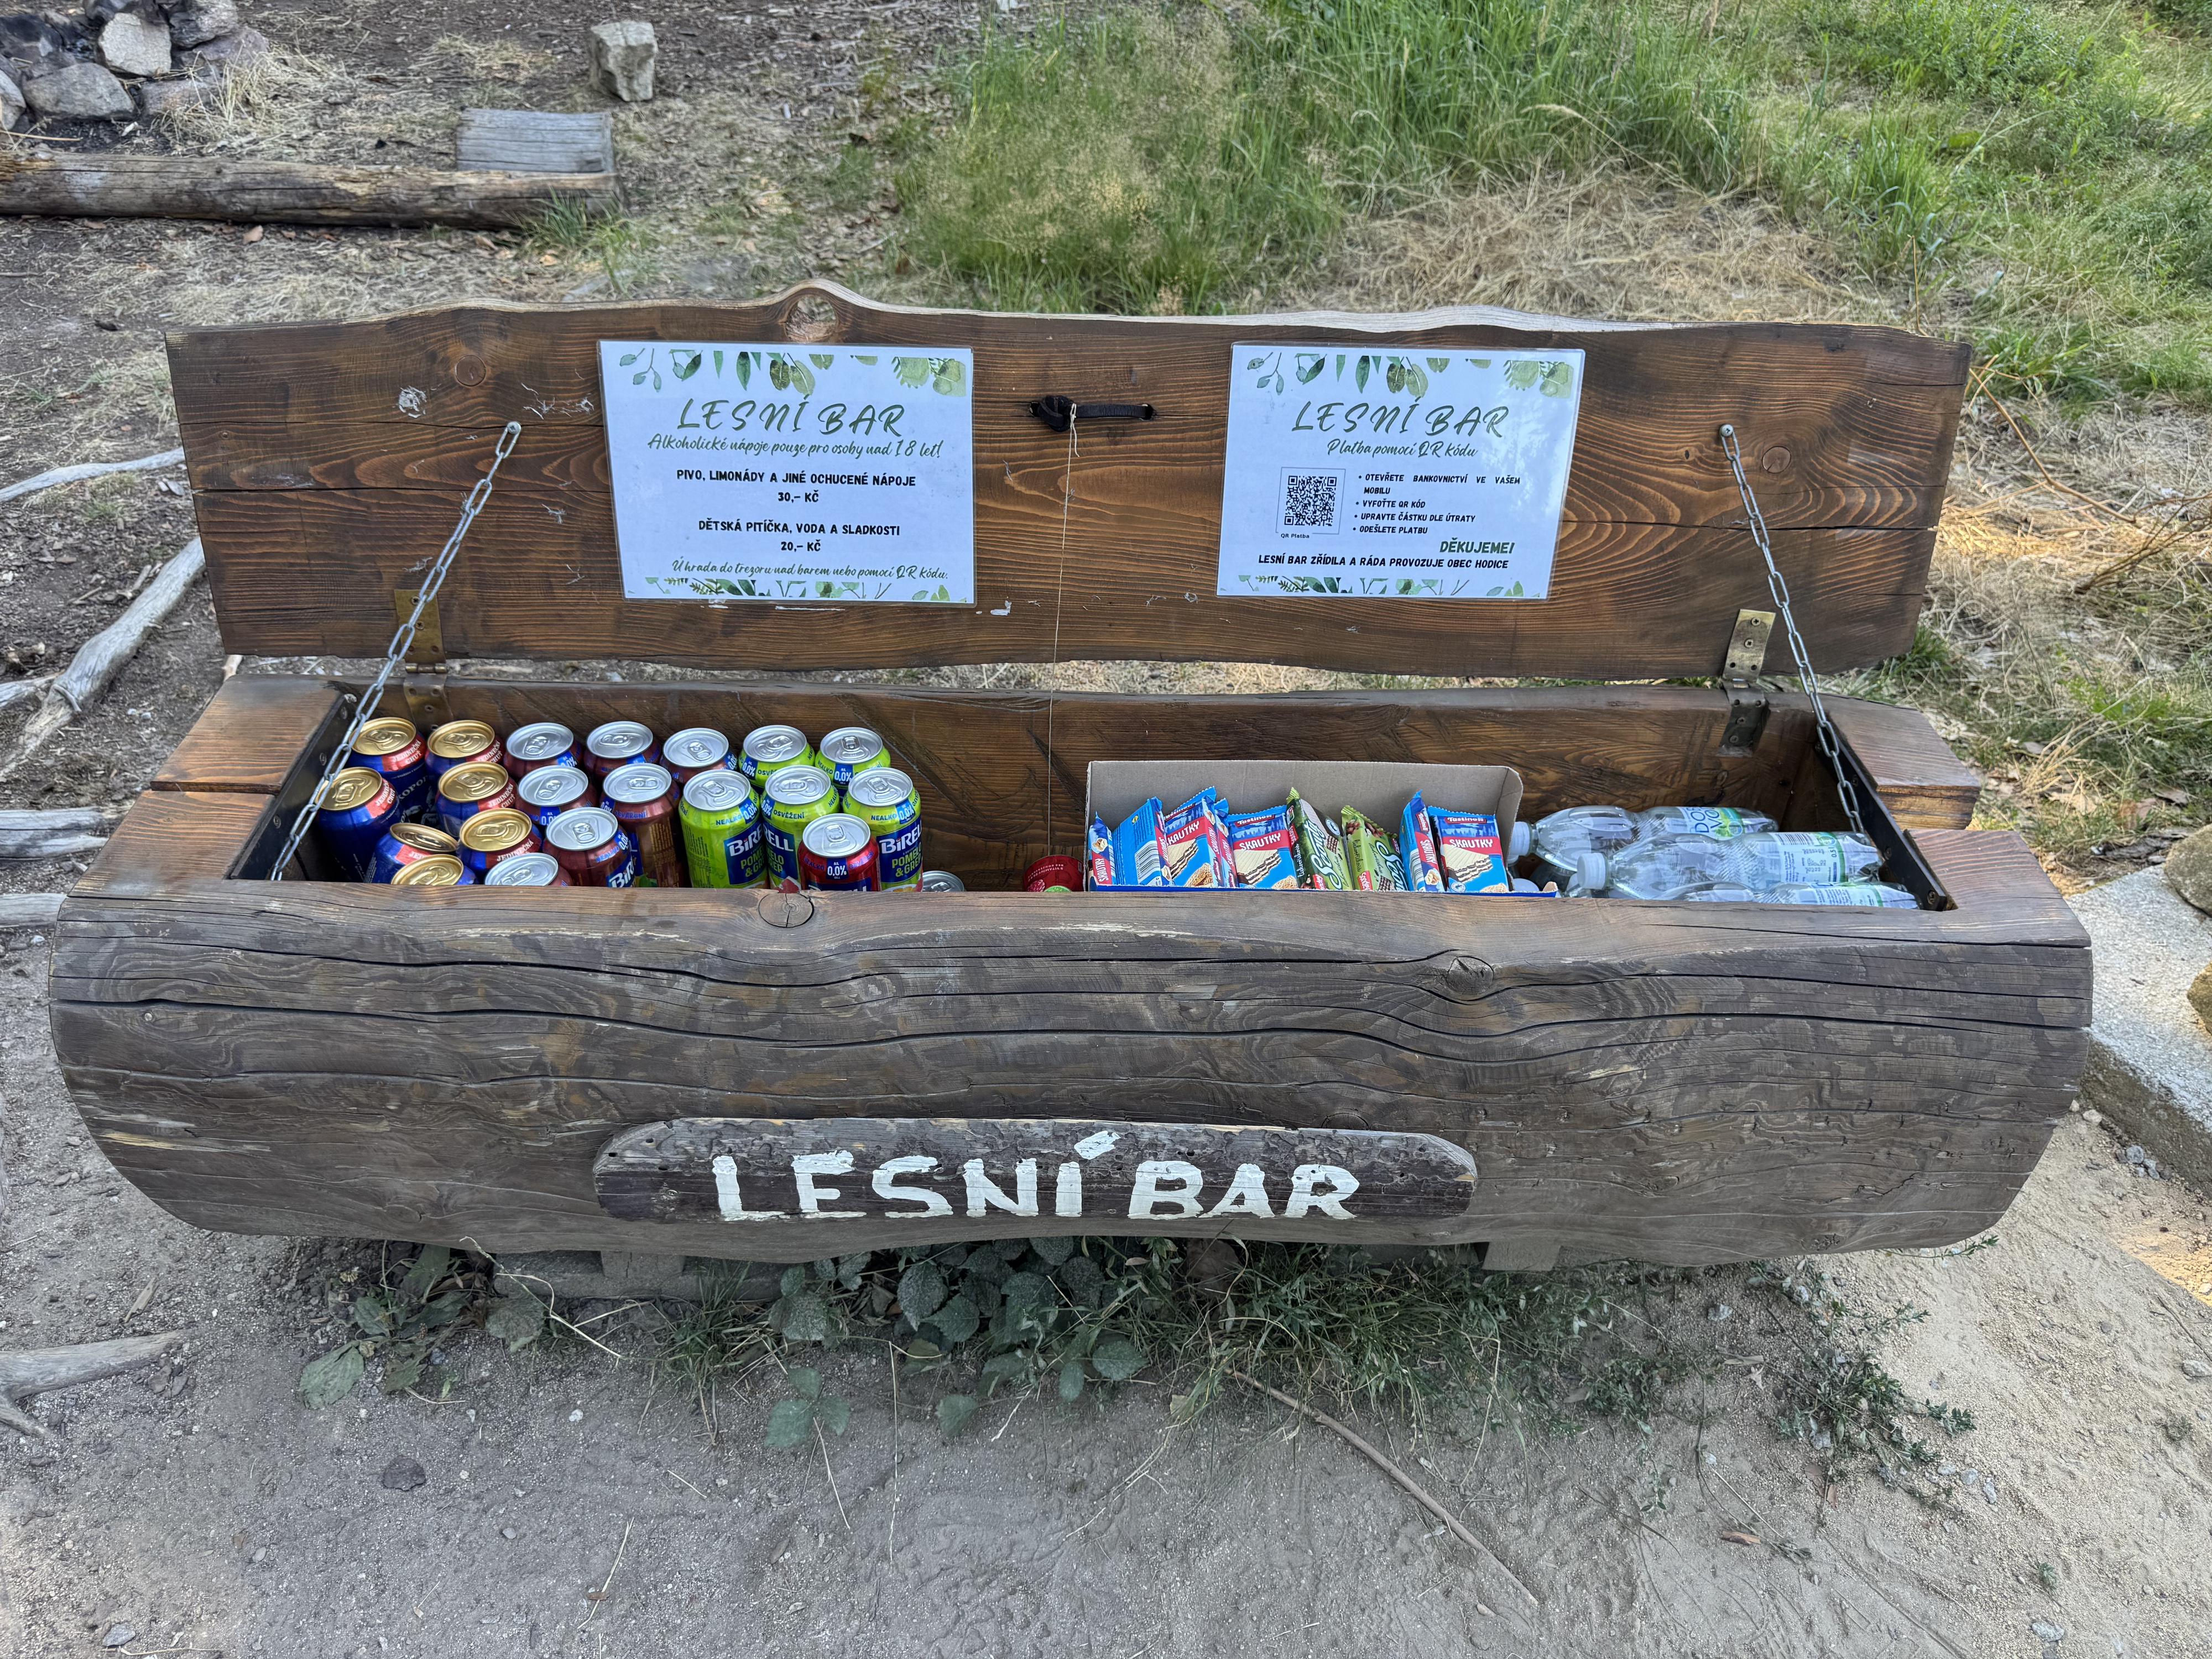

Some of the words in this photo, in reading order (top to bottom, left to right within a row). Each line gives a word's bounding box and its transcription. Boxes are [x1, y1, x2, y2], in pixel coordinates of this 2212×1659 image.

[677, 394, 810, 432] LESNÍ
[817, 403, 905, 437] BAR
[1292, 397, 1421, 434] LESNÍ
[1425, 405, 1509, 437] BAR
[648, 433, 728, 450] Alkoholické
[731, 439, 770, 456] nápoje
[771, 443, 808, 457] pouze
[808, 444, 829, 457] pro
[832, 441, 863, 460] osoby
[867, 442, 893, 455] nad
[920, 440, 944, 458] let!
[1327, 439, 1372, 456] Platba
[1373, 442, 1416, 458] pomocí
[1418, 441, 1444, 458] QR
[677, 469, 705, 481] PIVO,
[709, 468, 765, 482] LIMONÁDY
[770, 472, 778, 482] A
[782, 471, 806, 483] JINÉ
[810, 472, 868, 485] OCHUCENÉ
[873, 473, 916, 486] NÁPOJE
[1365, 472, 1405, 482] OTEVŘETE
[1413, 474, 1468, 483] BANKOVNICTVÍ
[1495, 474, 1520, 484] VAŠEM
[805, 490, 819, 503] KČ
[1363, 498, 1396, 508] VYFOŤTE
[1411, 499, 1426, 508] KÓD
[1398, 512, 1427, 521] ČÁSTKU
[1446, 513, 1475, 522] ÚTRATY
[698, 518, 742, 532] DĚTSKÁ
[747, 519, 792, 533] PITÍČKA,
[796, 523, 826, 534] VODA
[830, 524, 838, 534] A
[842, 524, 900, 536] SLADKOSTI
[1359, 524, 1396, 533] ODEŠLETE
[807, 539, 821, 552] KČ
[1439, 537, 1515, 554] DĚKUJEME!
[672, 556, 717, 573] Úhrada
[719, 561, 733, 573] do
[734, 562, 774, 577] trezoru
[774, 564, 796, 575] nad
[797, 564, 831, 576] barem
[833, 565, 857, 576] nebo
[858, 566, 894, 579] pomocí
[896, 565, 917, 579] QR
[1258, 553, 1286, 564] LESNÍ
[1287, 556, 1307, 564] BAR
[1310, 554, 1345, 565] ZŘÍDILA
[1349, 557, 1356, 566] A
[1360, 555, 1386, 566] RÁDA
[1389, 558, 1444, 567] PROVOZUJE
[1447, 559, 1472, 568] OBEC
[1475, 560, 1509, 568] HODICE
[716, 813, 743, 826] NEALKO
[774, 809, 805, 819] OSVĚŽENÍ
[1239, 832, 1281, 851] SKAUTKY
[1449, 839, 1493, 848] SKAUTKY
[1420, 839, 1437, 864] SKAUTKY
[827, 865, 847, 876] 0,0%
[895, 868, 903, 877] &
[712, 1130, 1121, 1221] LESNÍ
[1126, 1160, 1360, 1220] BAR
